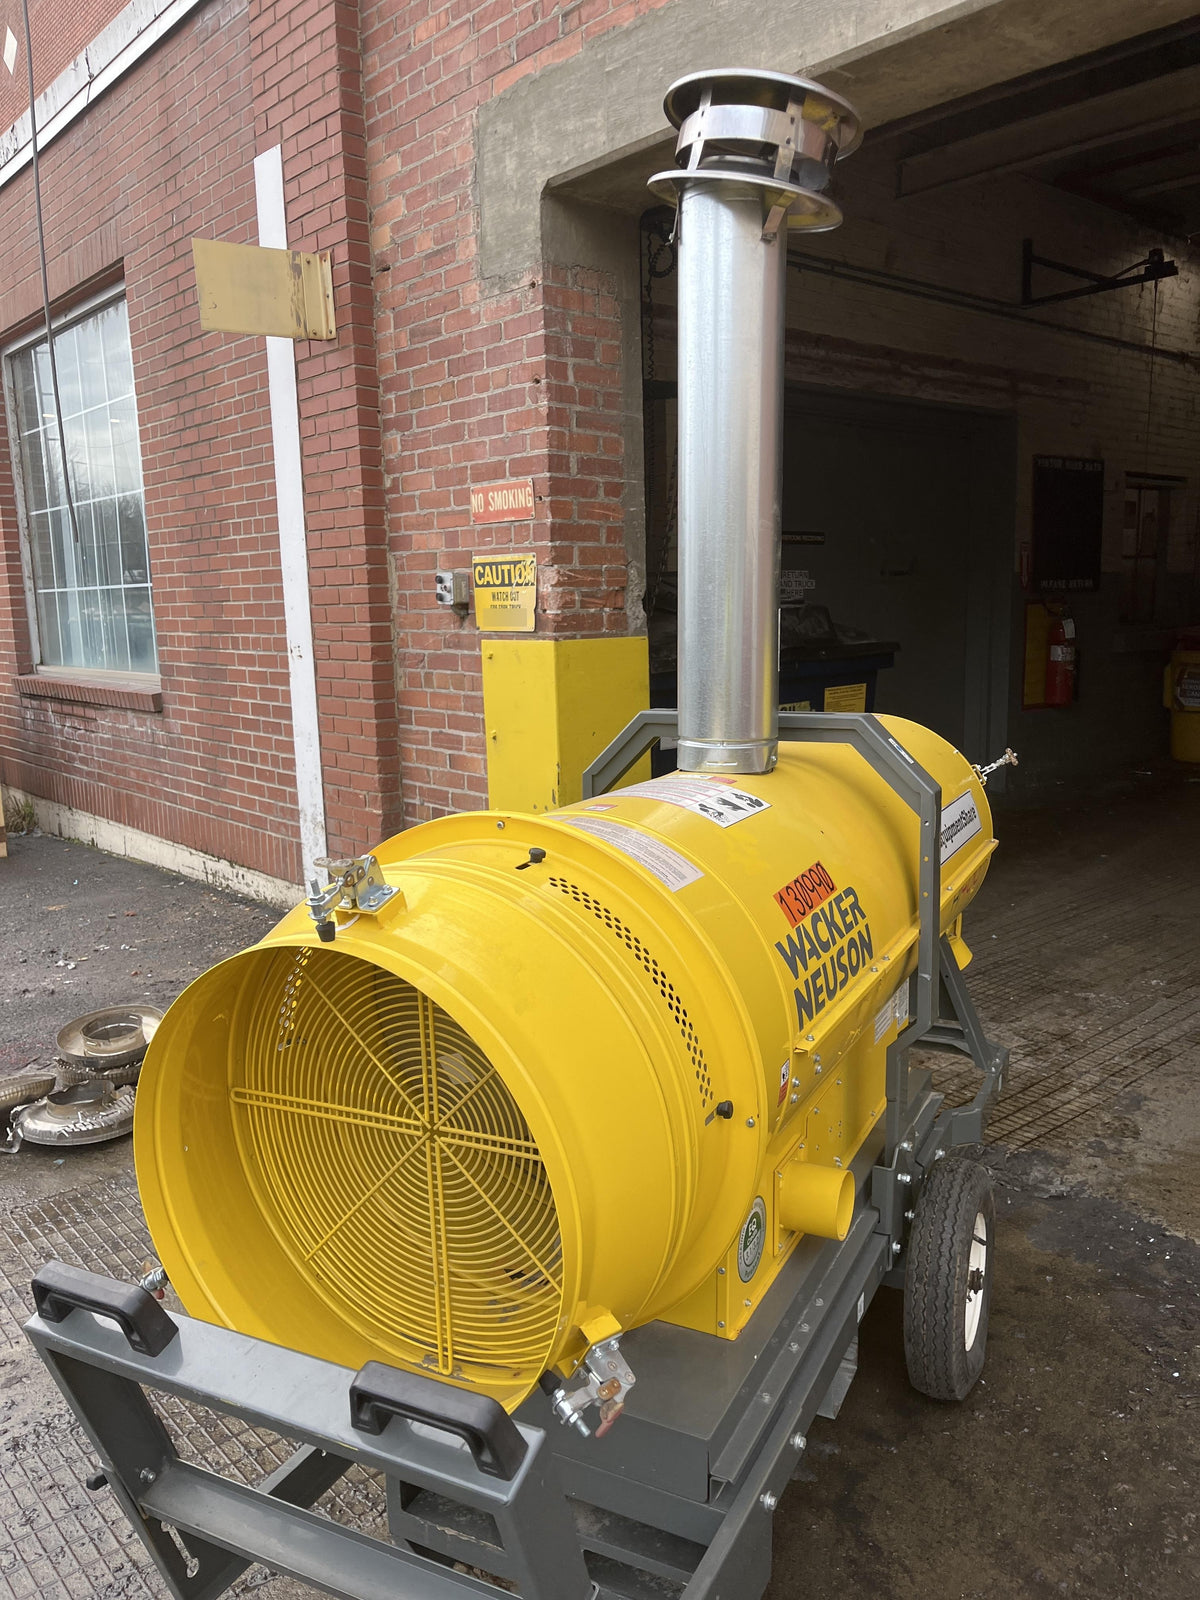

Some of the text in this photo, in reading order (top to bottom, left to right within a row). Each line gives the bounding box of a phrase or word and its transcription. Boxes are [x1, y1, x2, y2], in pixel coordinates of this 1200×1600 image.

[472, 487, 533, 513] NO SMOKING
[474, 563, 536, 586] CAUTION
[491, 591, 520, 602] WATCH OUT
[778, 863, 835, 922] 130990
[774, 886, 867, 980] WACKER
[793, 923, 874, 1032] NEUSON
